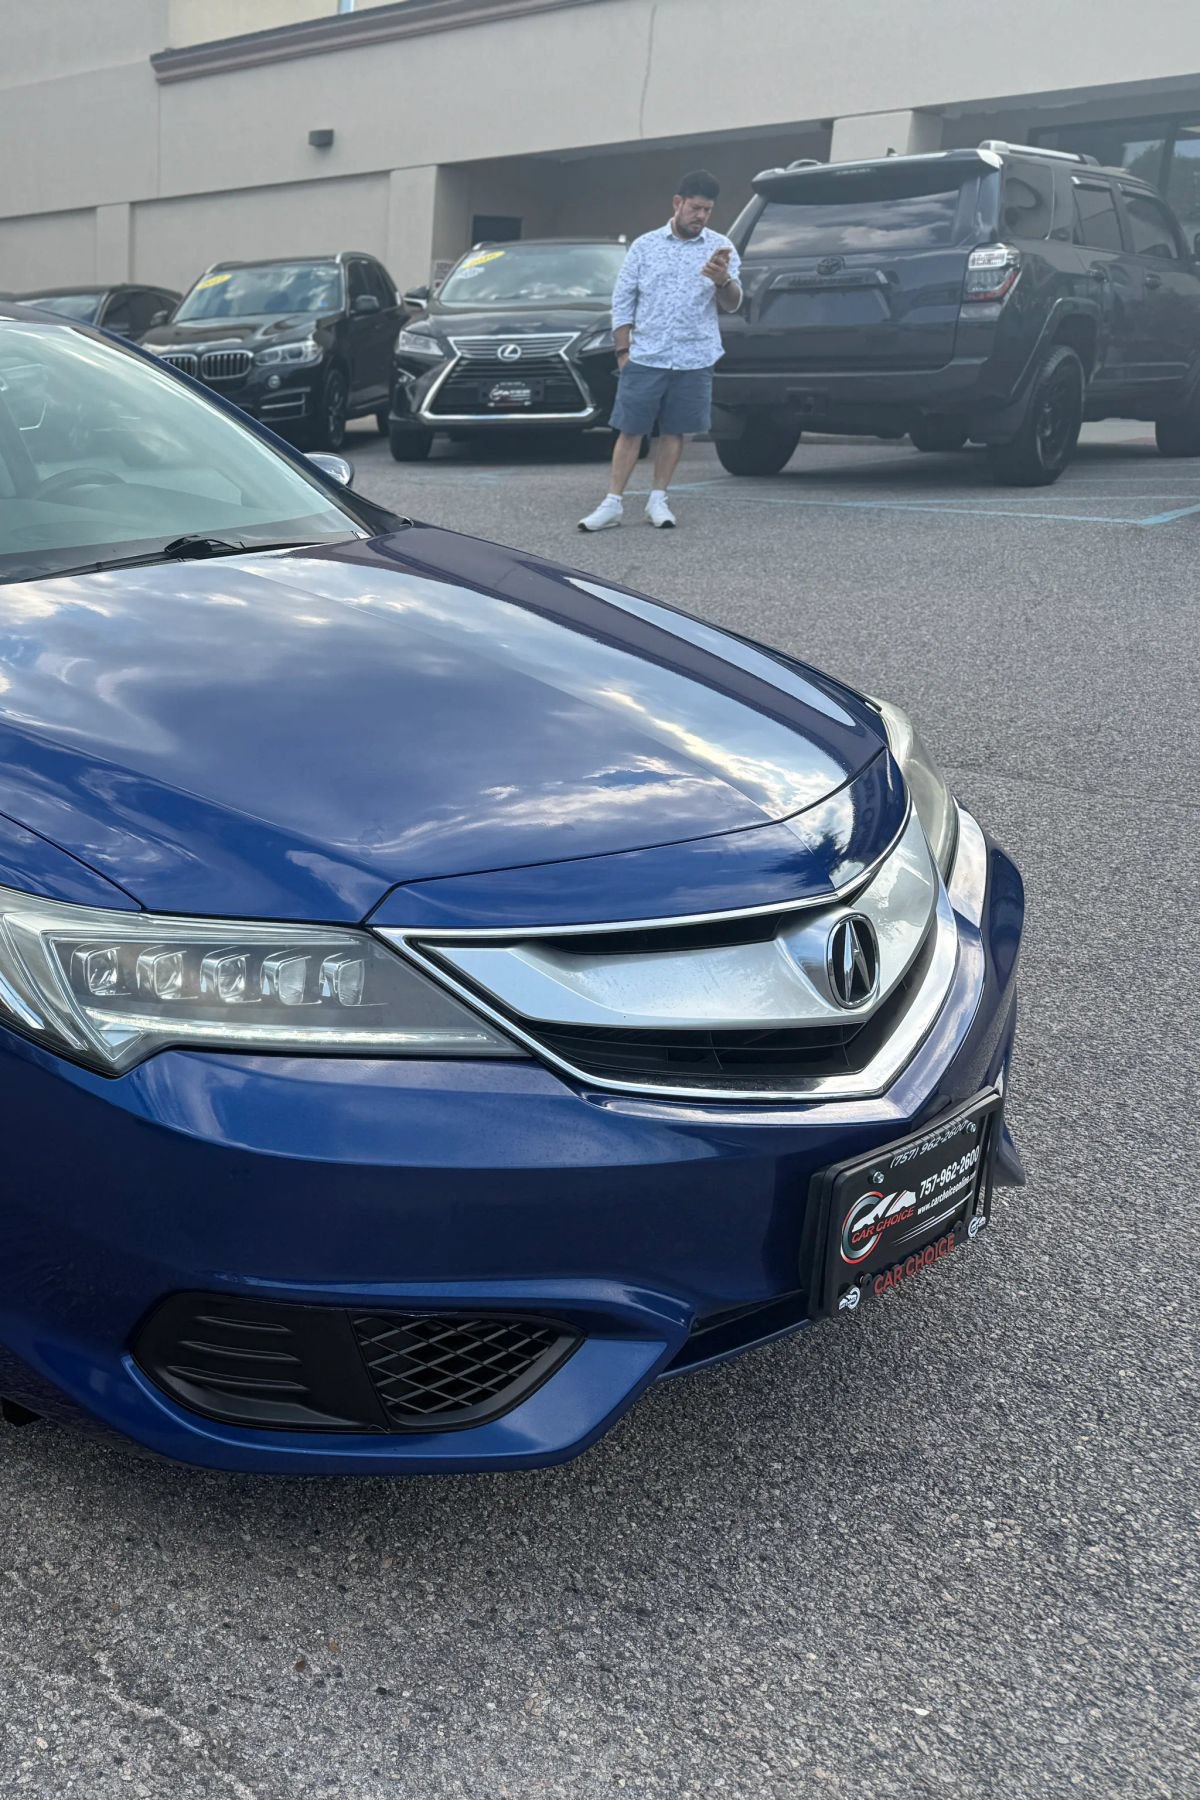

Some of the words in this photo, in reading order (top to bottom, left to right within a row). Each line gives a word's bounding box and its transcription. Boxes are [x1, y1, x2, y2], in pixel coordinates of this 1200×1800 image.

[890, 1147, 919, 1169] (757)
[919, 1145, 980, 1199] 757-962-2600
[851, 1225, 875, 1244] CAR
[875, 1206, 915, 1232] CHOICE
[874, 1264, 903, 1295] CAR
[905, 1232, 956, 1276] CHOICE
